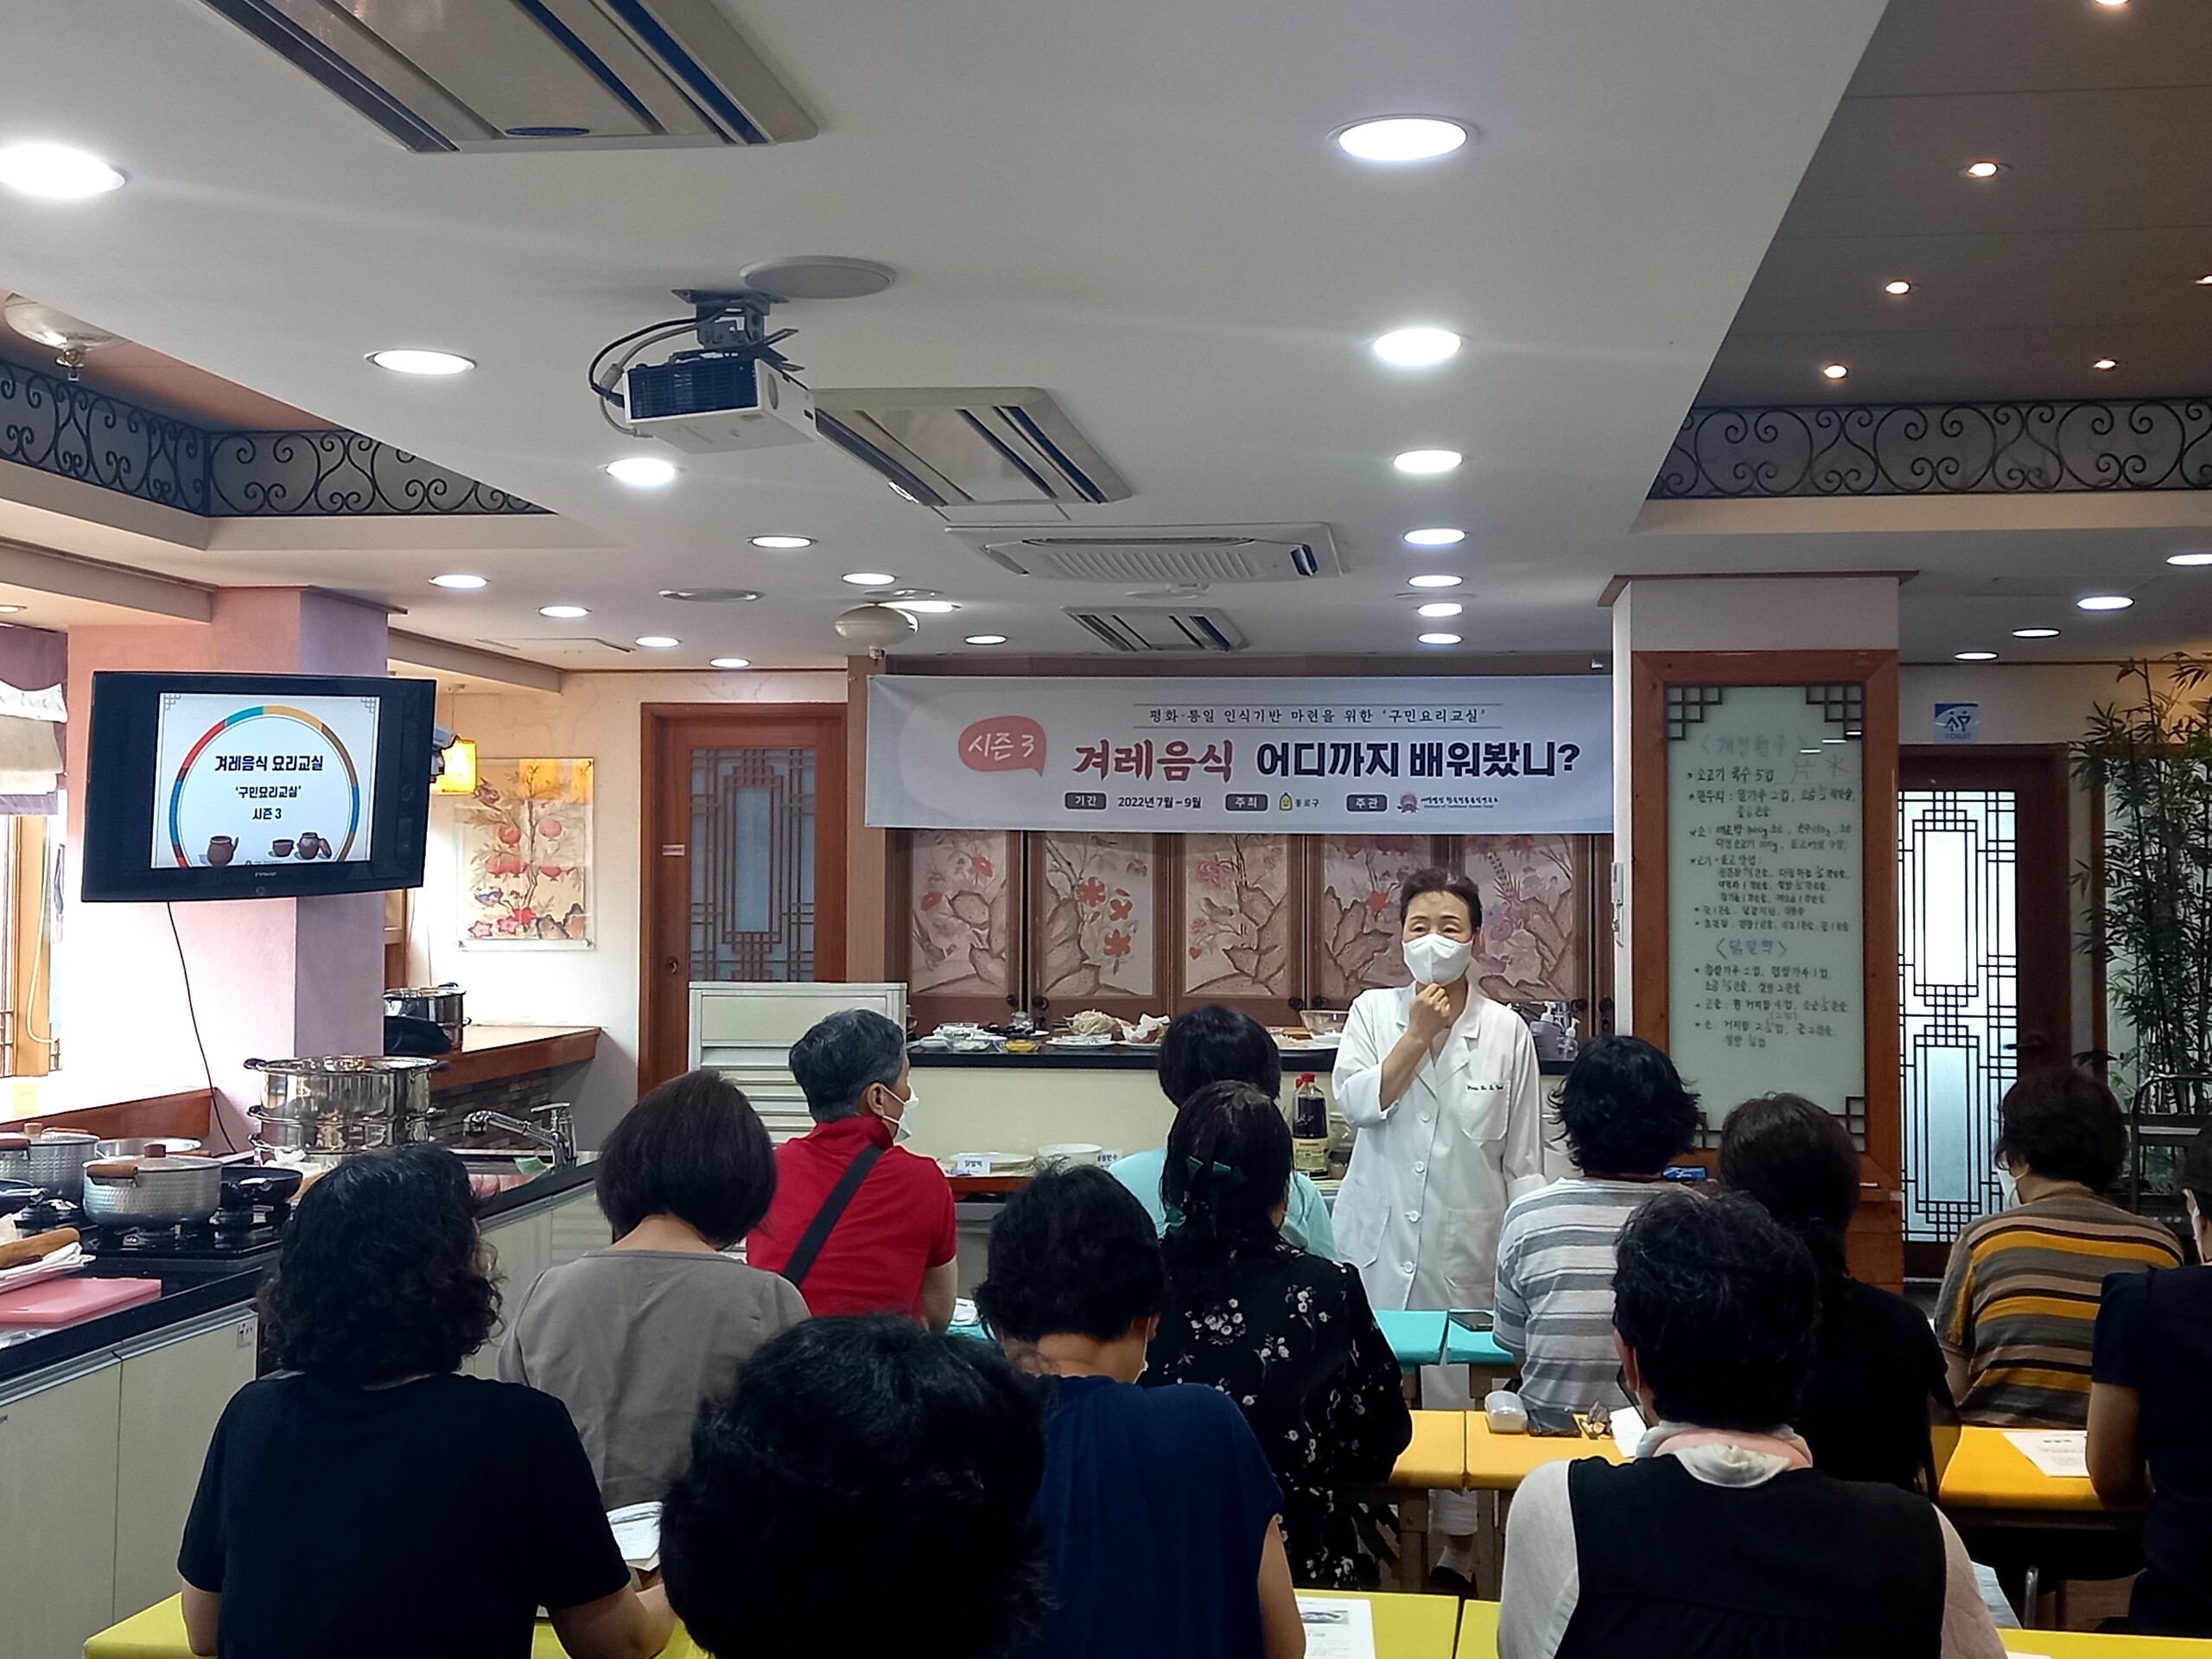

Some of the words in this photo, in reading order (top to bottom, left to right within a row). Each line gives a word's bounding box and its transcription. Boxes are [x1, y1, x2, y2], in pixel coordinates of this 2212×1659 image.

[1224, 709, 1281, 723] 인식기반
[1291, 709, 1335, 723] 마련을
[1344, 709, 1373, 723] 위한
[968, 733, 1014, 761] 시즌
[1021, 734, 1034, 758] 3
[214, 755, 268, 772] 겨레음식
[271, 755, 324, 772] 요리교실
[1072, 739, 1233, 783] 겨레음식
[1256, 741, 1399, 778] 어디까지
[1409, 741, 1580, 778] 배워봤니?
[1075, 795, 1097, 807] 기간
[1118, 797, 1155, 809] 2022년
[1235, 797, 1258, 809] 주최
[1355, 797, 1378, 810] 주관
[252, 808, 273, 820] 시즌
[275, 808, 283, 820] 3
